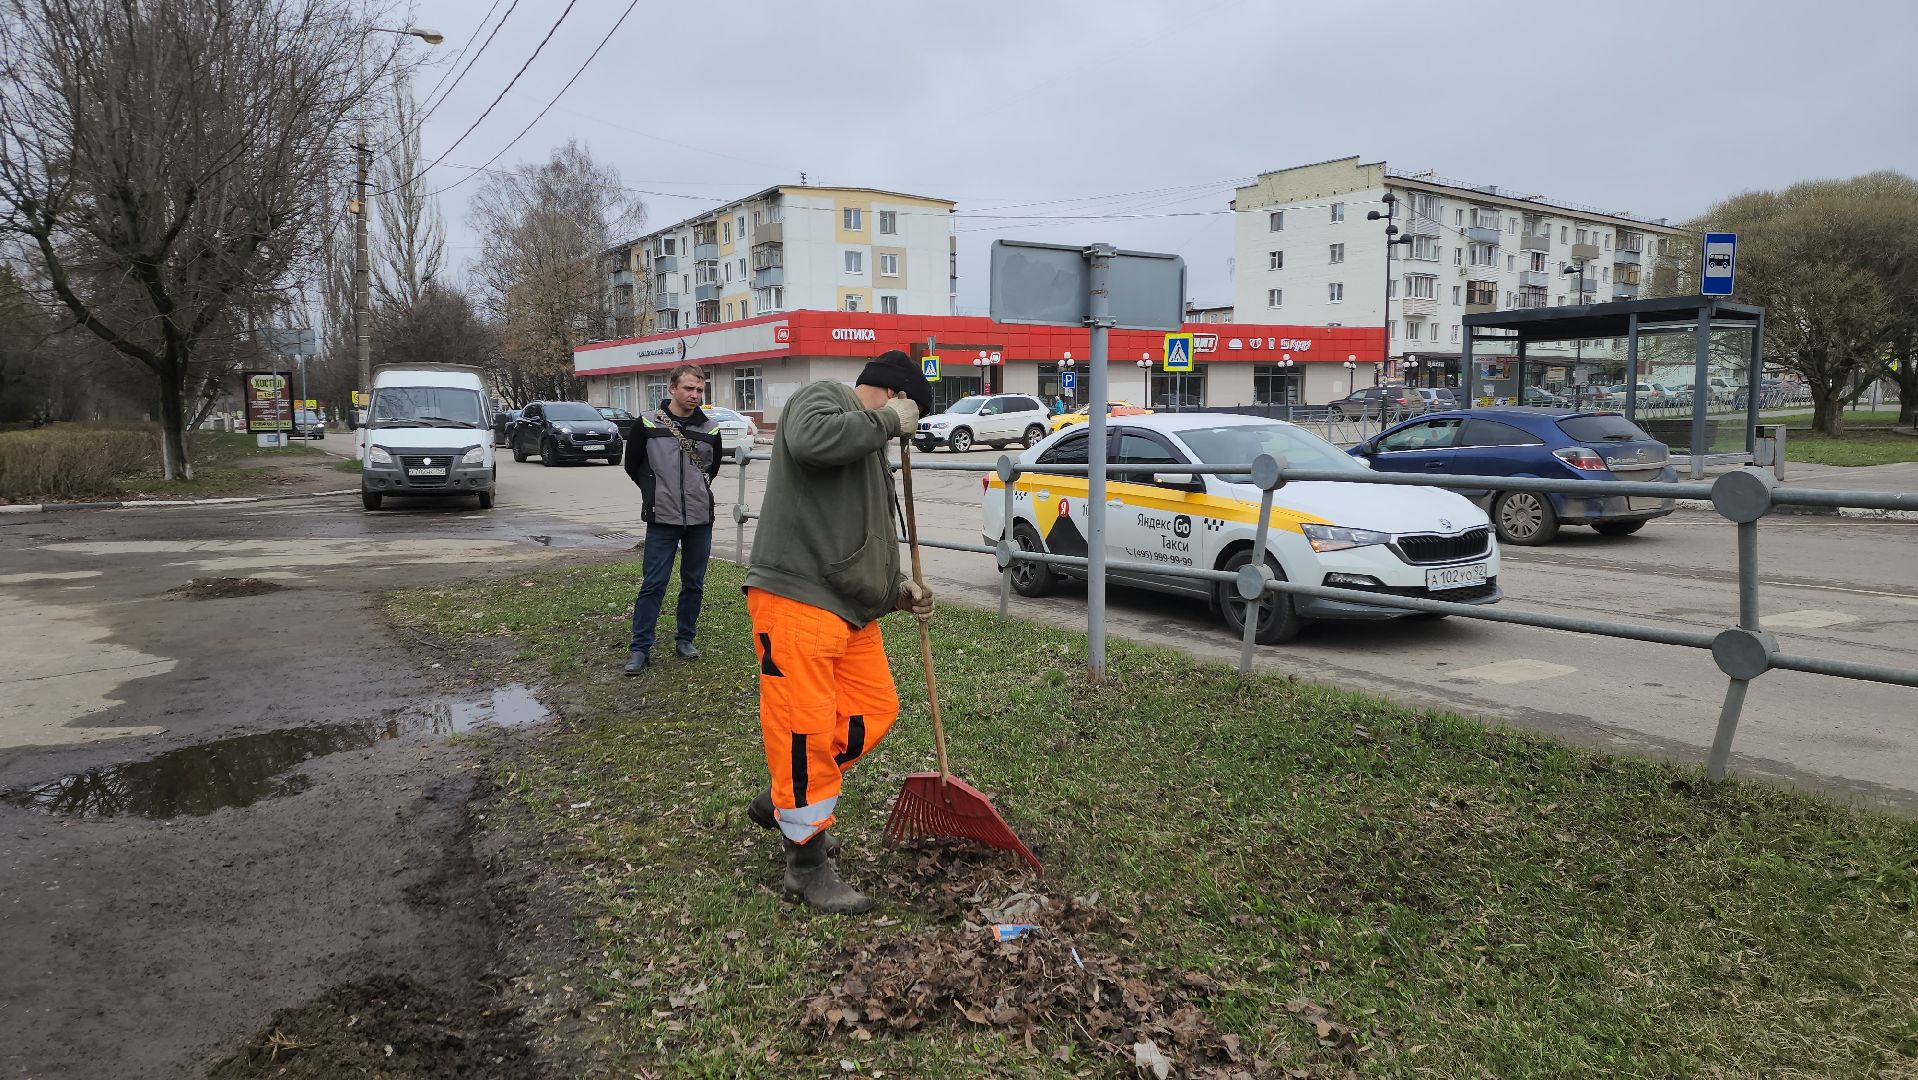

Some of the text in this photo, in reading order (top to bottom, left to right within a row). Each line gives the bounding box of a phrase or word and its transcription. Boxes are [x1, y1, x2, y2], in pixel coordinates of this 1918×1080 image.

[832, 328, 875, 340] ОПТИКА
[1061, 502, 1067, 514] Я
[1137, 513, 1191, 535] Яндекс Go
[1160, 534, 1189, 552] Такси
[1133, 547, 1193, 567] (495) 999-99-99
